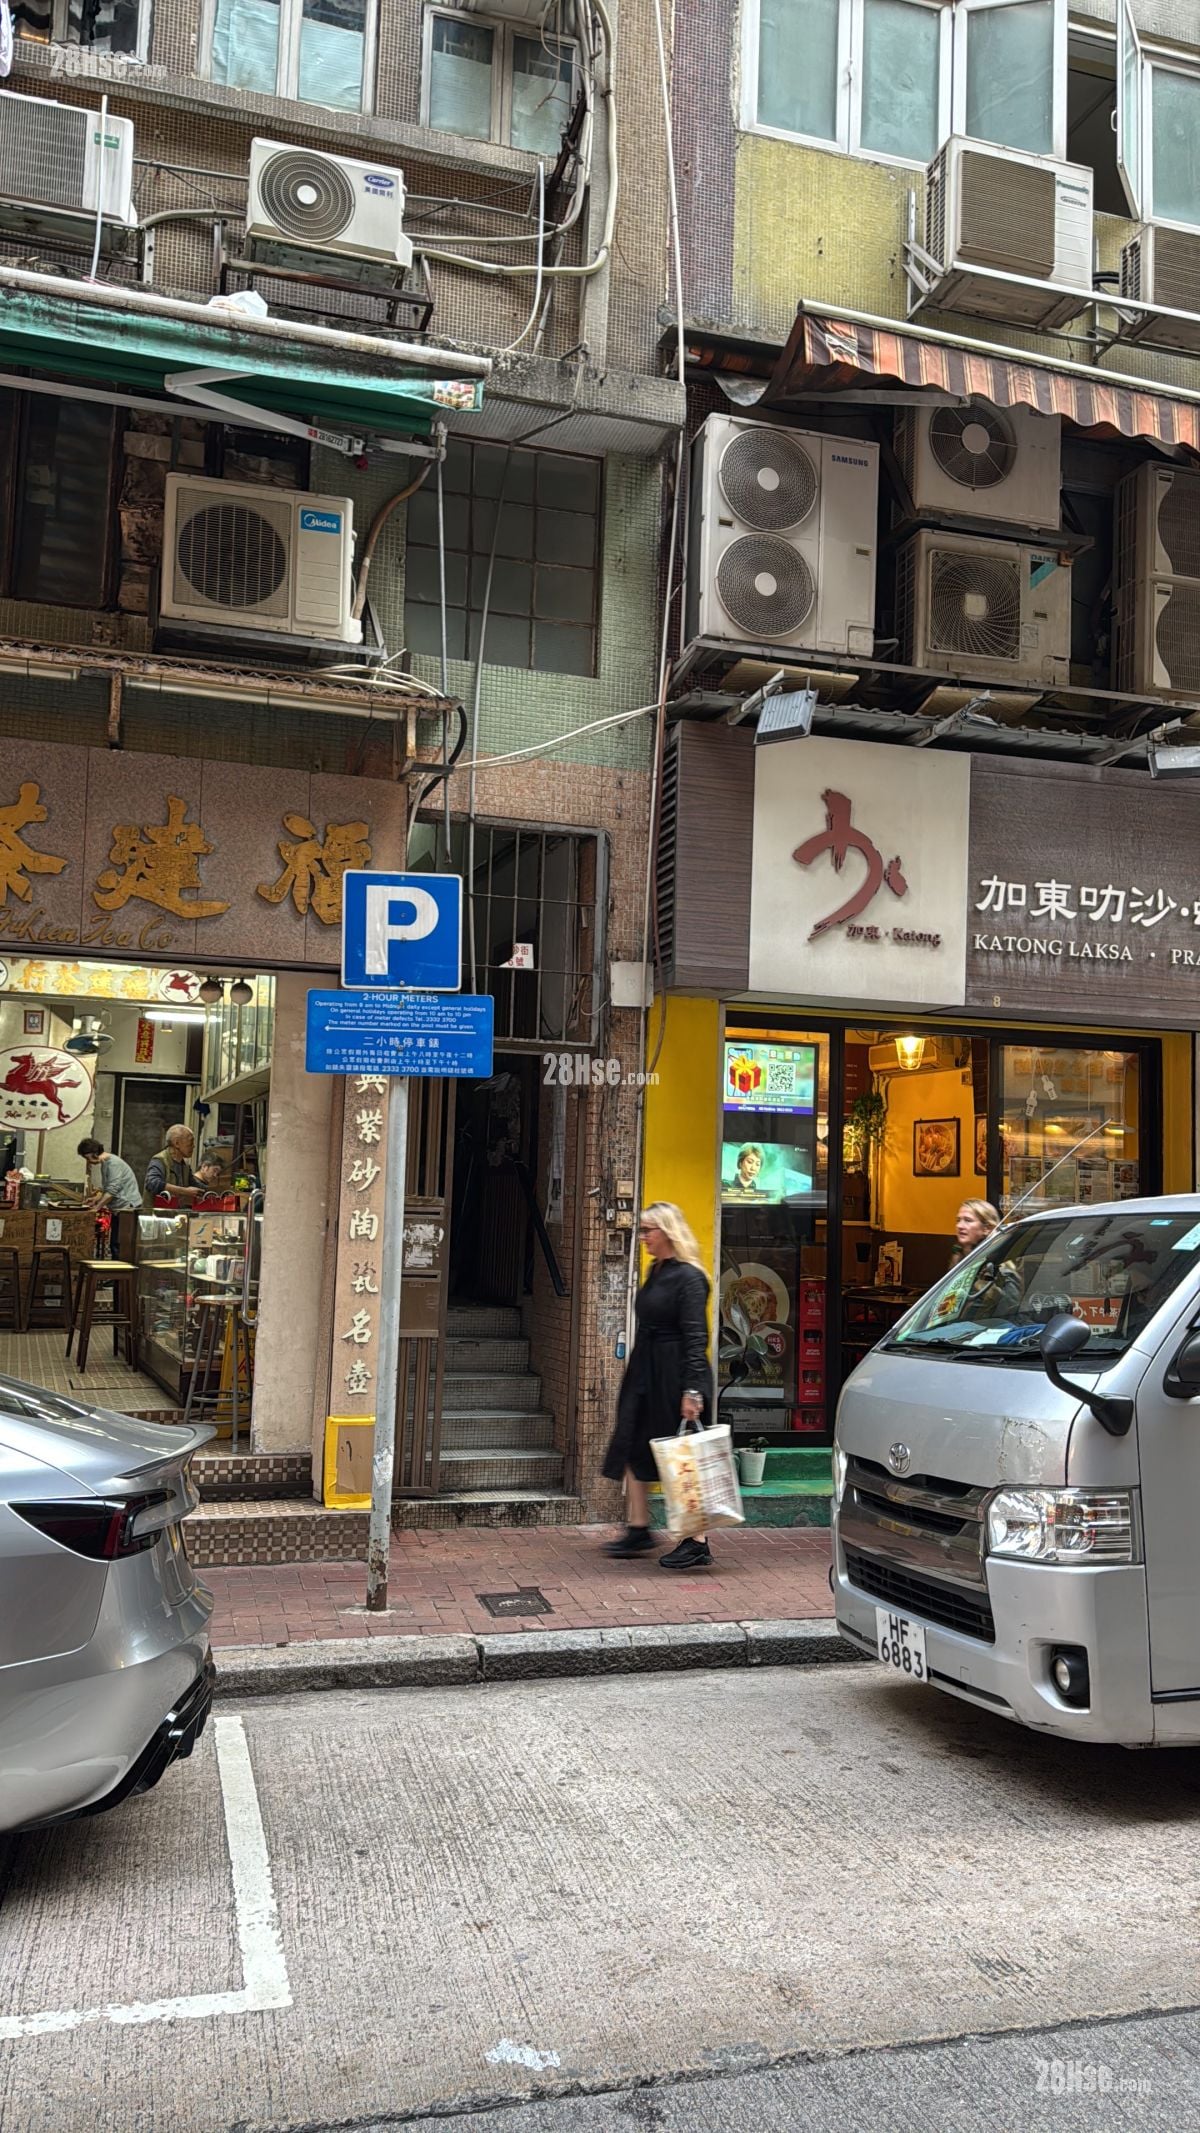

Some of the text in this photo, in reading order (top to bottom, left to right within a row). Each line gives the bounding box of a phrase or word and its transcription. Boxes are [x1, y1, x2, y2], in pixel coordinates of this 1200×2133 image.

[367, 176, 391, 186] Carrier
[831, 455, 869, 467] SAMSUNG
[309, 515, 337, 530] Midea
[365, 885, 439, 975] P
[974, 934, 1063, 955] KATONG
[1069, 942, 1133, 960] LAKSA
[363, 993, 439, 1003] 2-HOUR METERS
[993, 996, 1001, 1007] 8
[889, 1613, 909, 1645] HF
[881, 1636, 924, 1679] 6883
